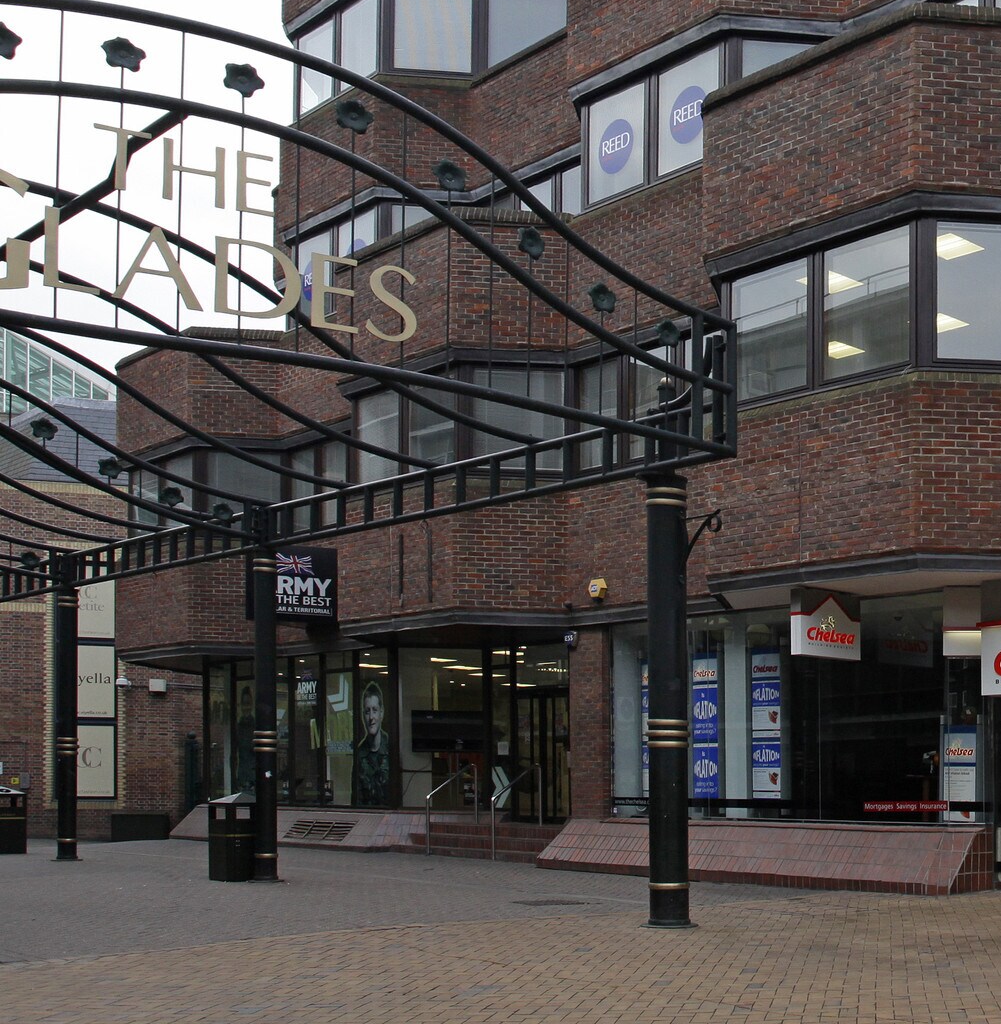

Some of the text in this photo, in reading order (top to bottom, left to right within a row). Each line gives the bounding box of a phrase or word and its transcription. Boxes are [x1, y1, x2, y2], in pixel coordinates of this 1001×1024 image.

[673, 99, 704, 126] REED
[602, 132, 630, 157] REED
[94, 123, 275, 216] THE
[276, 575, 332, 596] RMY
[276, 594, 332, 607] THE BEST
[294, 607, 331, 615] TERRITORIAL
[806, 627, 855, 645] Chelsea
[78, 673, 111, 686] yella
[864, 803, 894, 811] Mortgages
[896, 803, 917, 812] Savings
